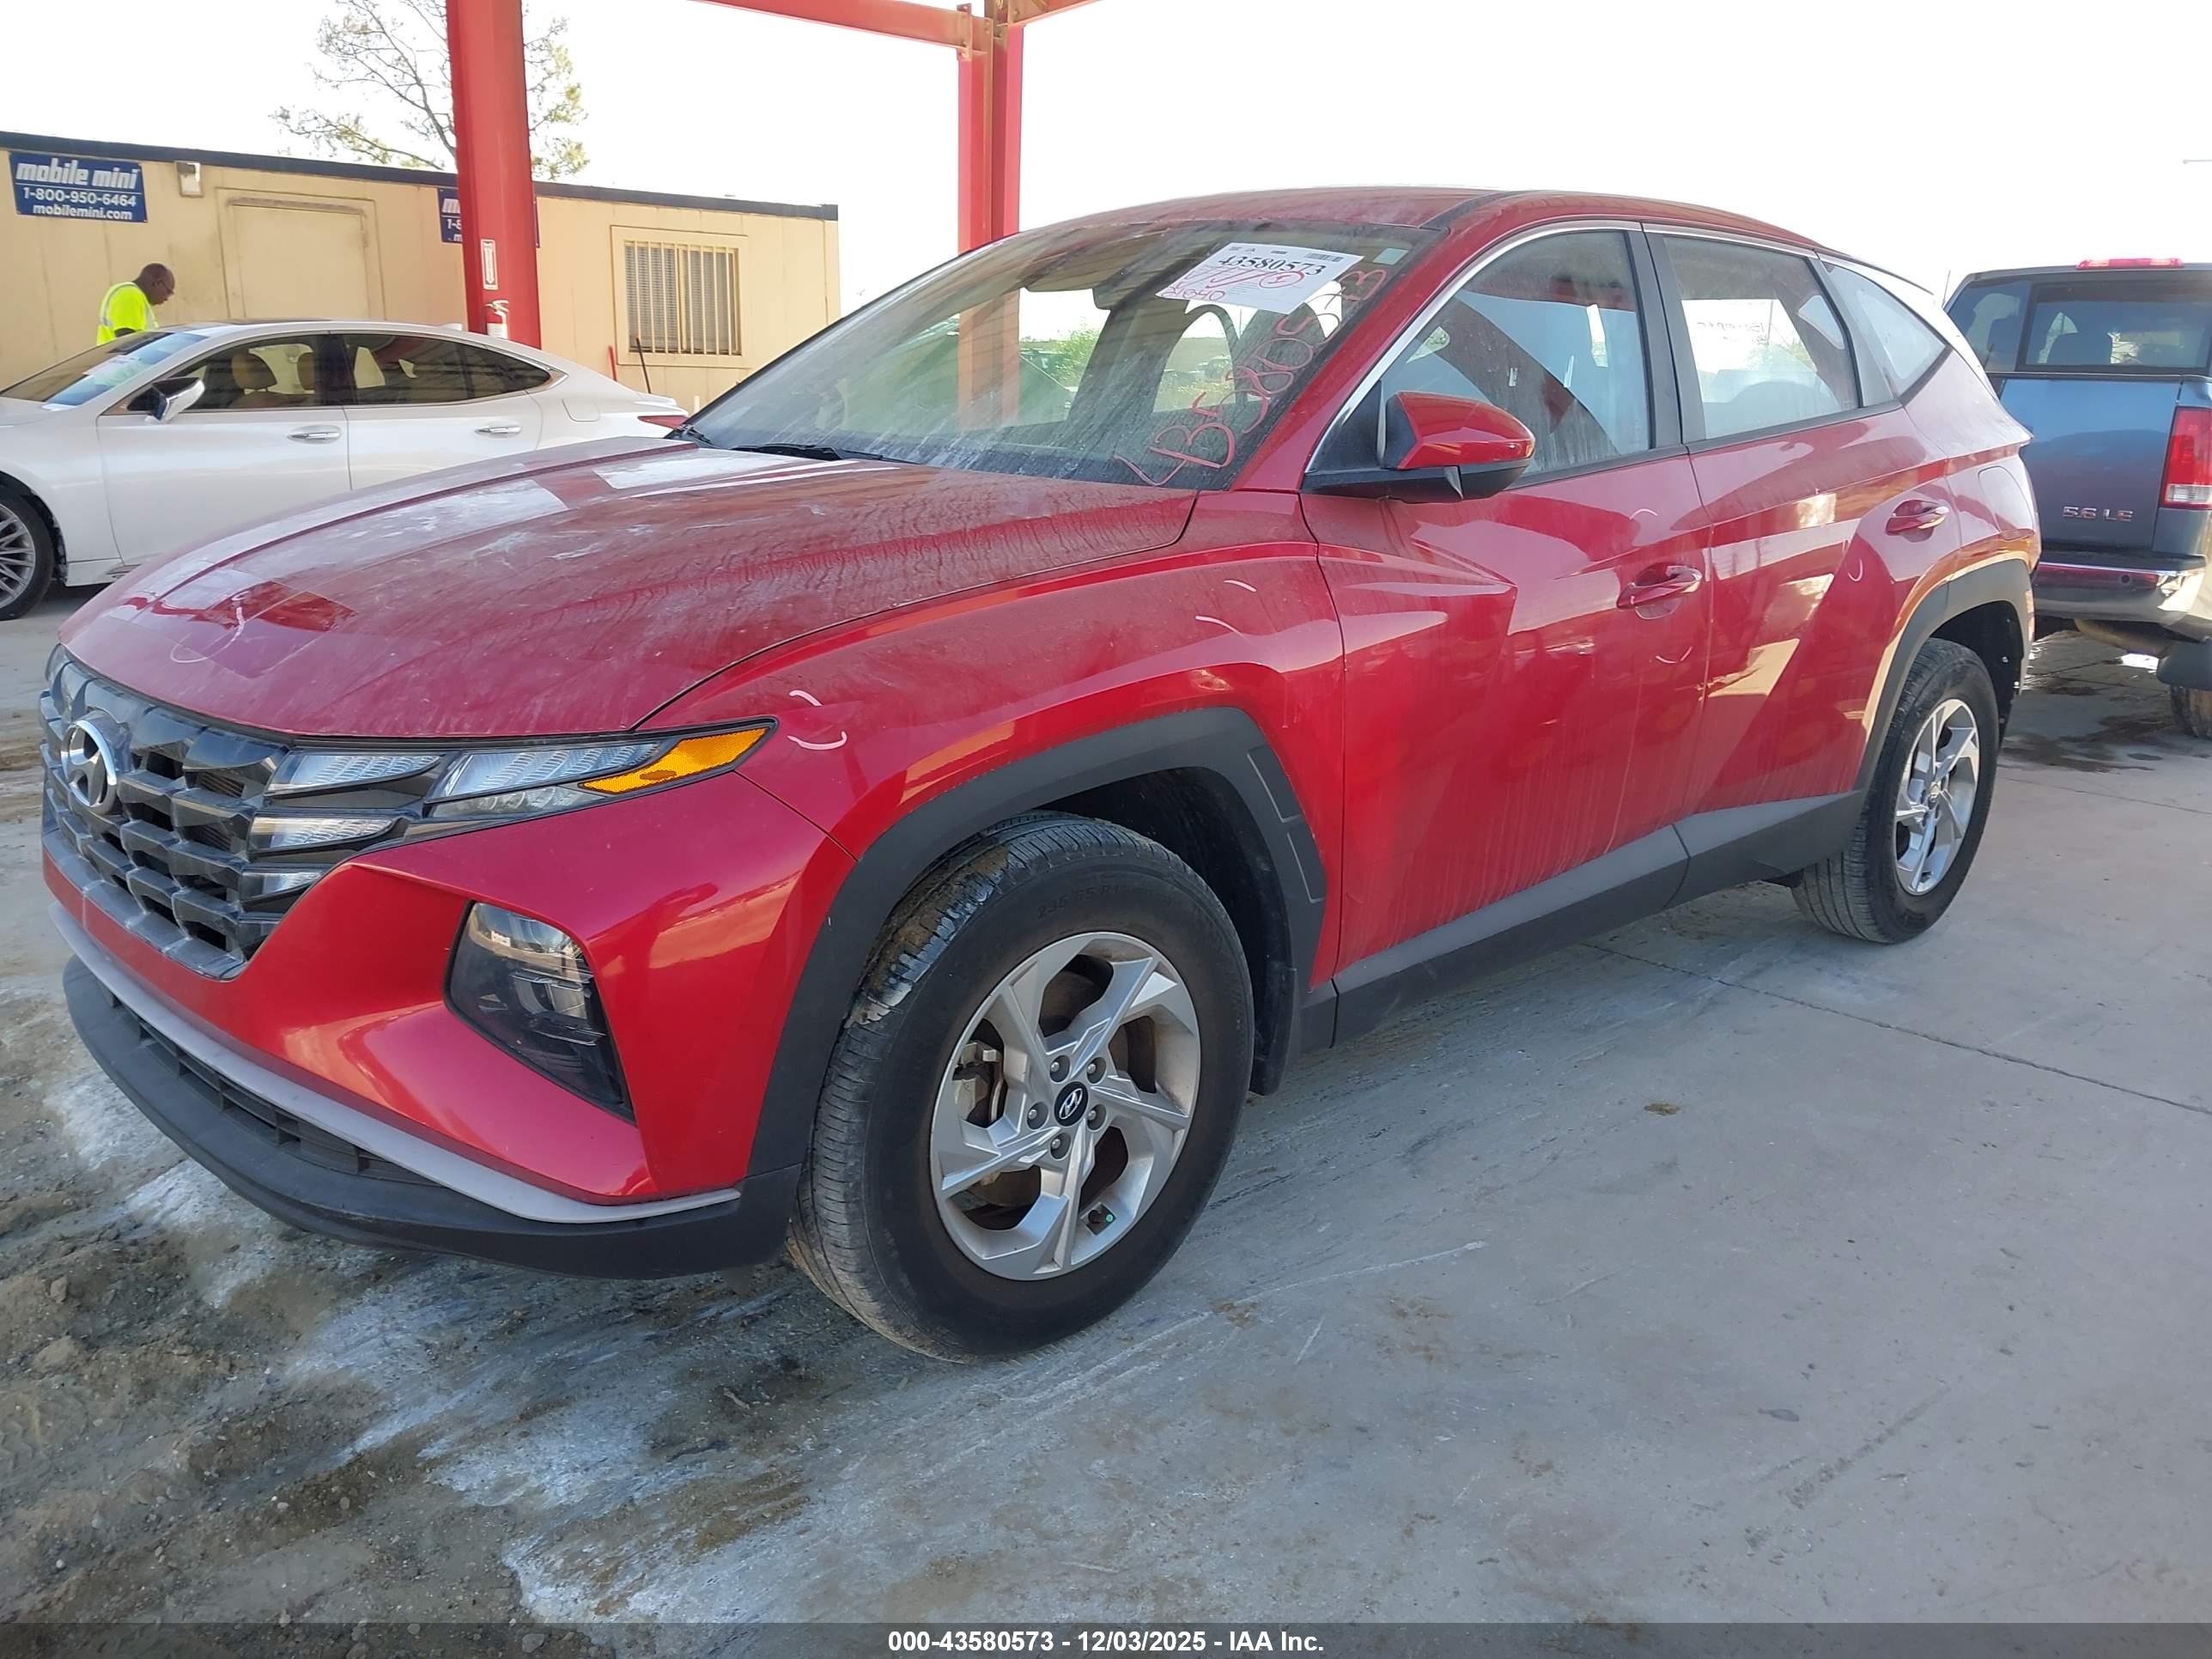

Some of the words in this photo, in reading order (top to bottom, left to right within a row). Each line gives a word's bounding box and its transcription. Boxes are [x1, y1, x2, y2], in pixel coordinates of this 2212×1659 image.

[15, 158, 88, 185] mobile
[92, 167, 141, 190] mini
[23, 187, 137, 207] 1-800-950-6464
[33, 204, 132, 220] mobilemini.com
[1218, 255, 1327, 276] 43580573
